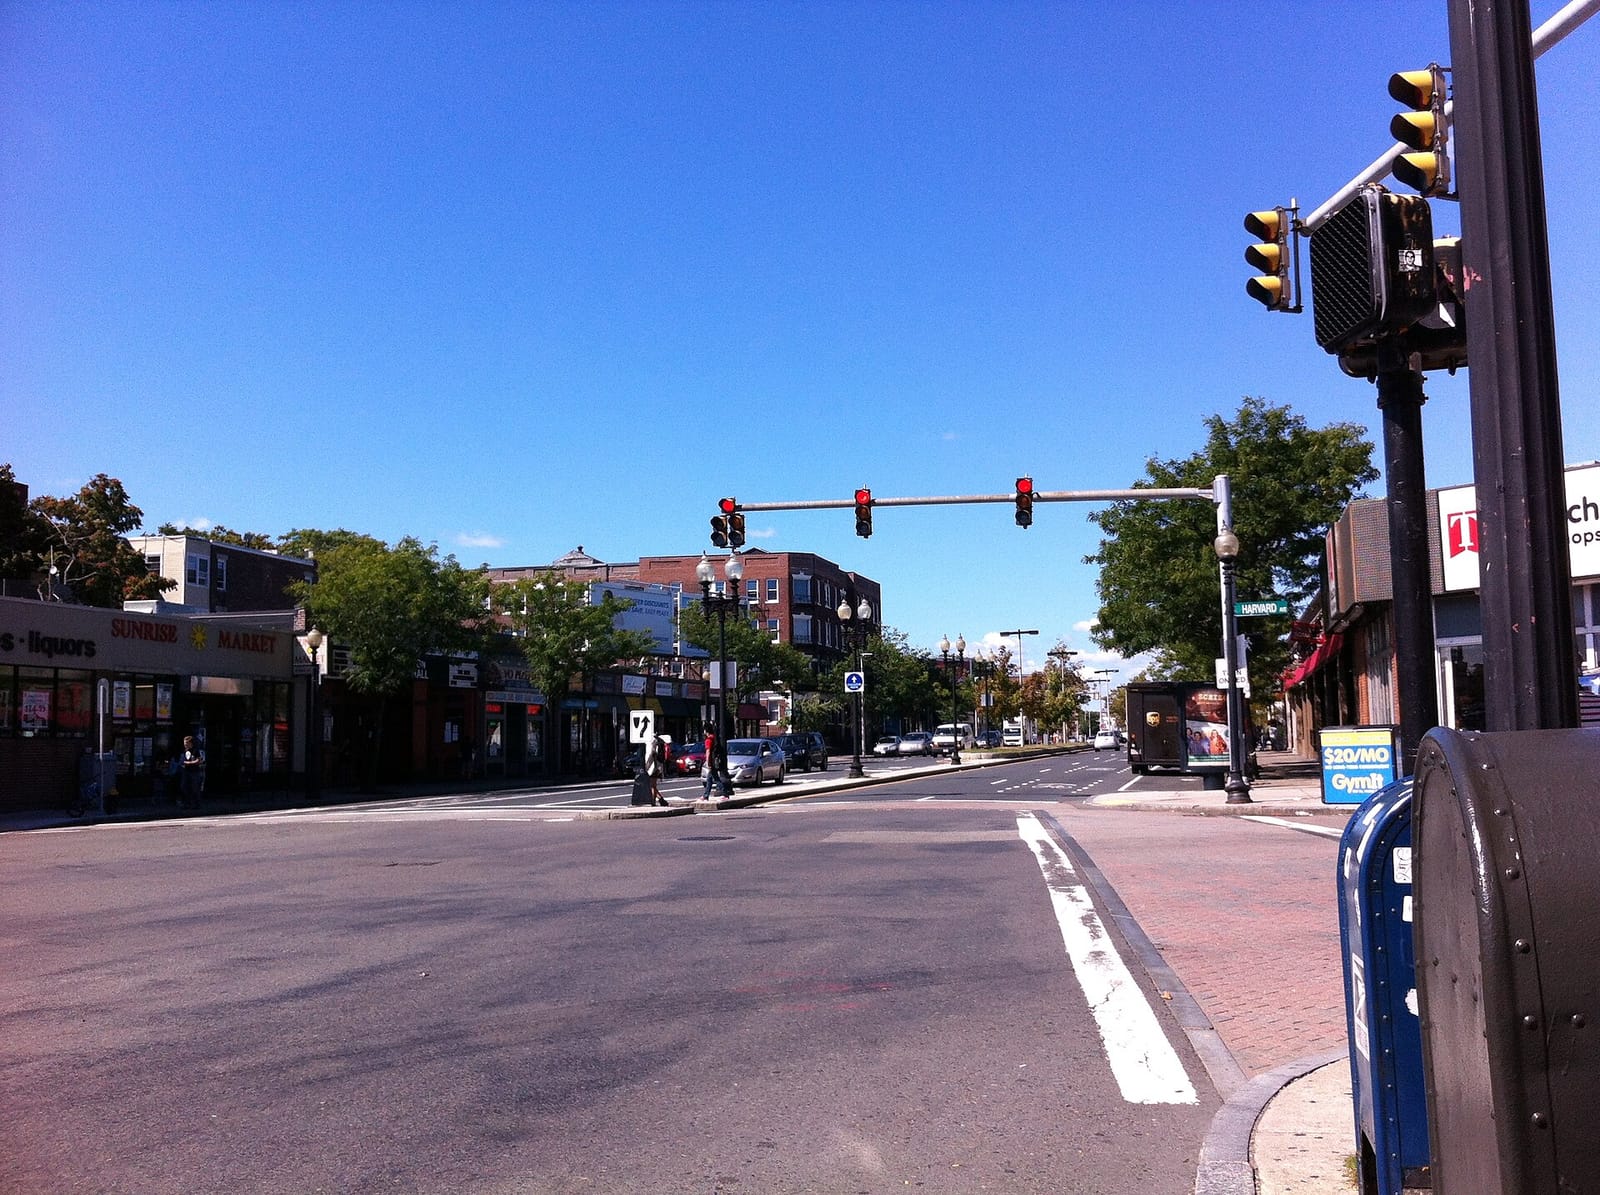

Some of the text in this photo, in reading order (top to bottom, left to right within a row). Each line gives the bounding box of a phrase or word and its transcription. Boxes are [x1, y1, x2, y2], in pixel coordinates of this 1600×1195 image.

[1241, 603, 1277, 614] HARVARD
[28, 630, 96, 658] liquors
[111, 619, 276, 653] SUNRISE MARKET
[1324, 747, 1389, 765] $20/MO
